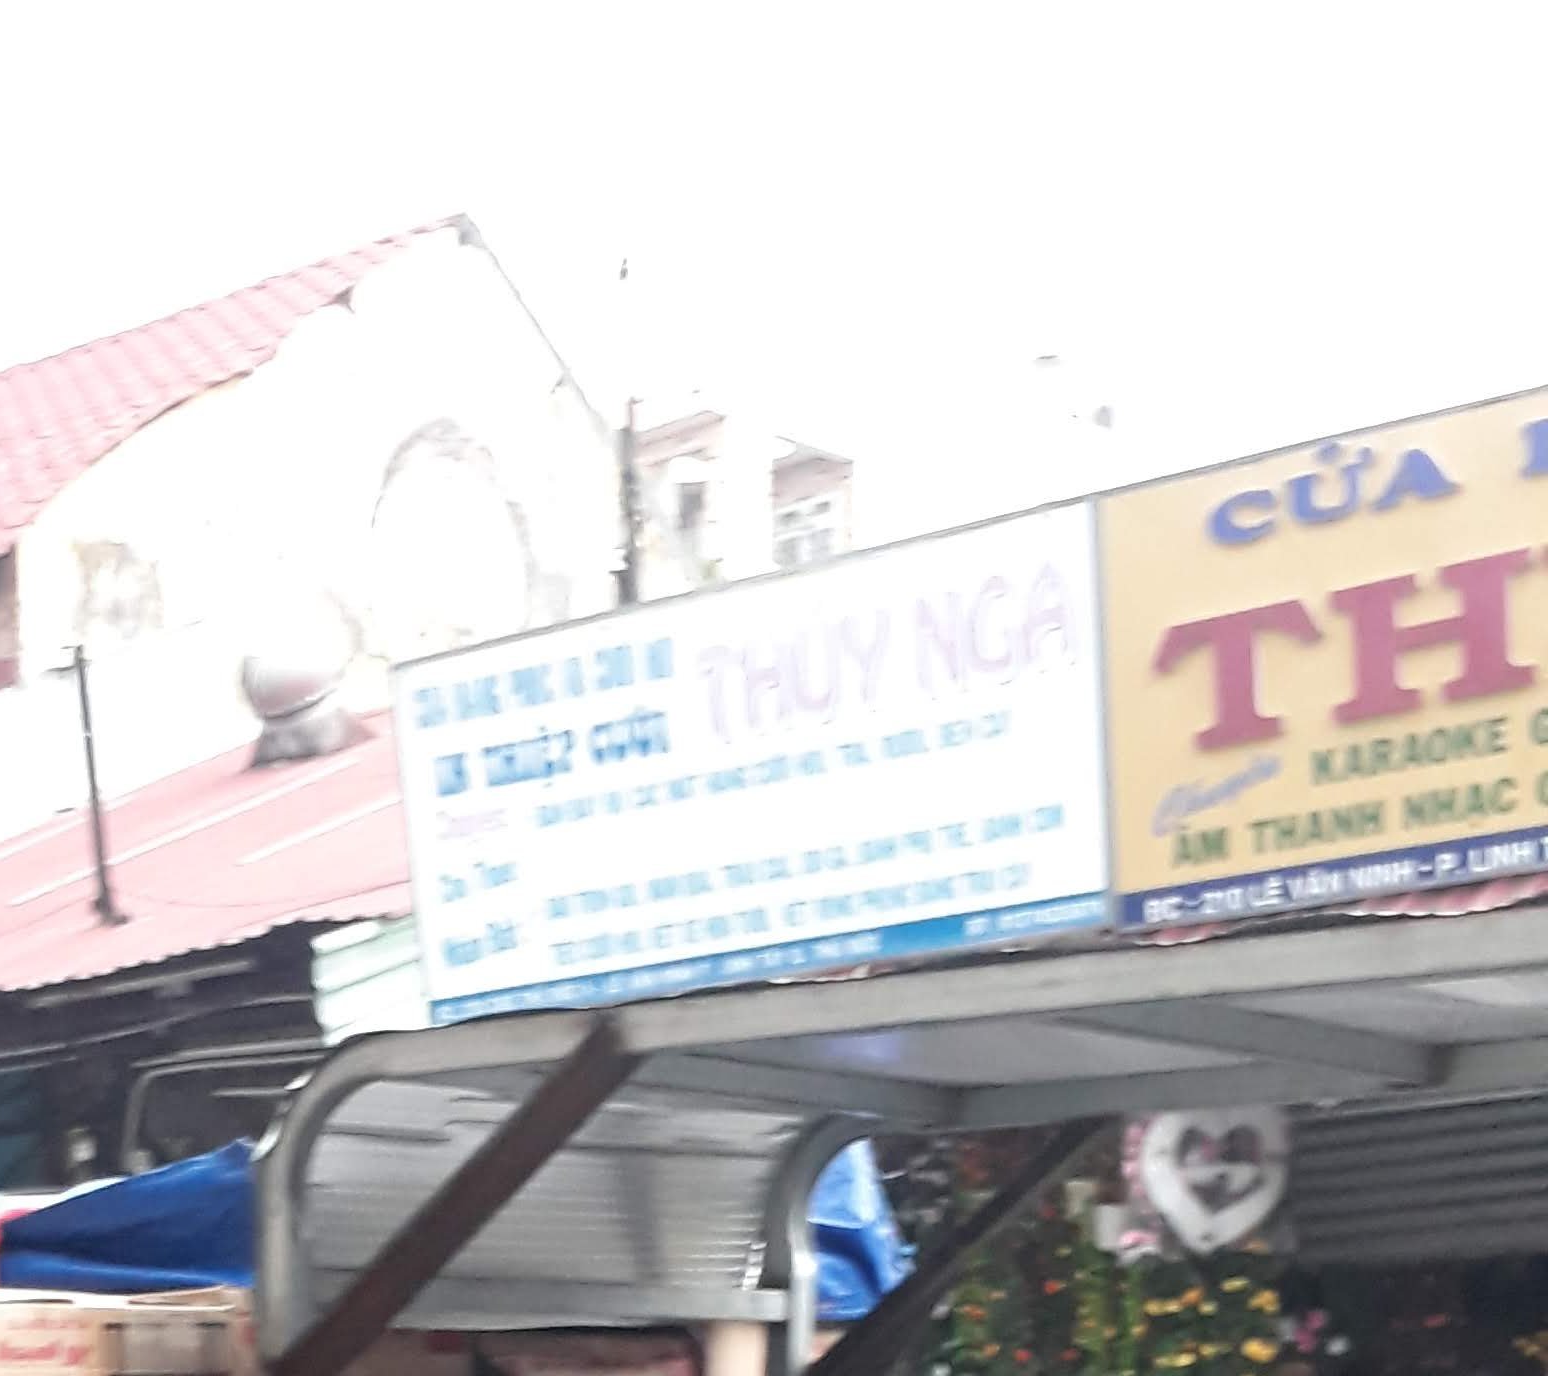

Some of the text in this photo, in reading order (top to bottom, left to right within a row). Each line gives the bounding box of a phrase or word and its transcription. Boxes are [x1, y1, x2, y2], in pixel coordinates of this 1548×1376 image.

[1206, 441, 1462, 546] CỬA
[1150, 545, 1548, 751] TH
[1309, 717, 1509, 787] KARAOKE
[1248, 801, 1386, 854] THANH
